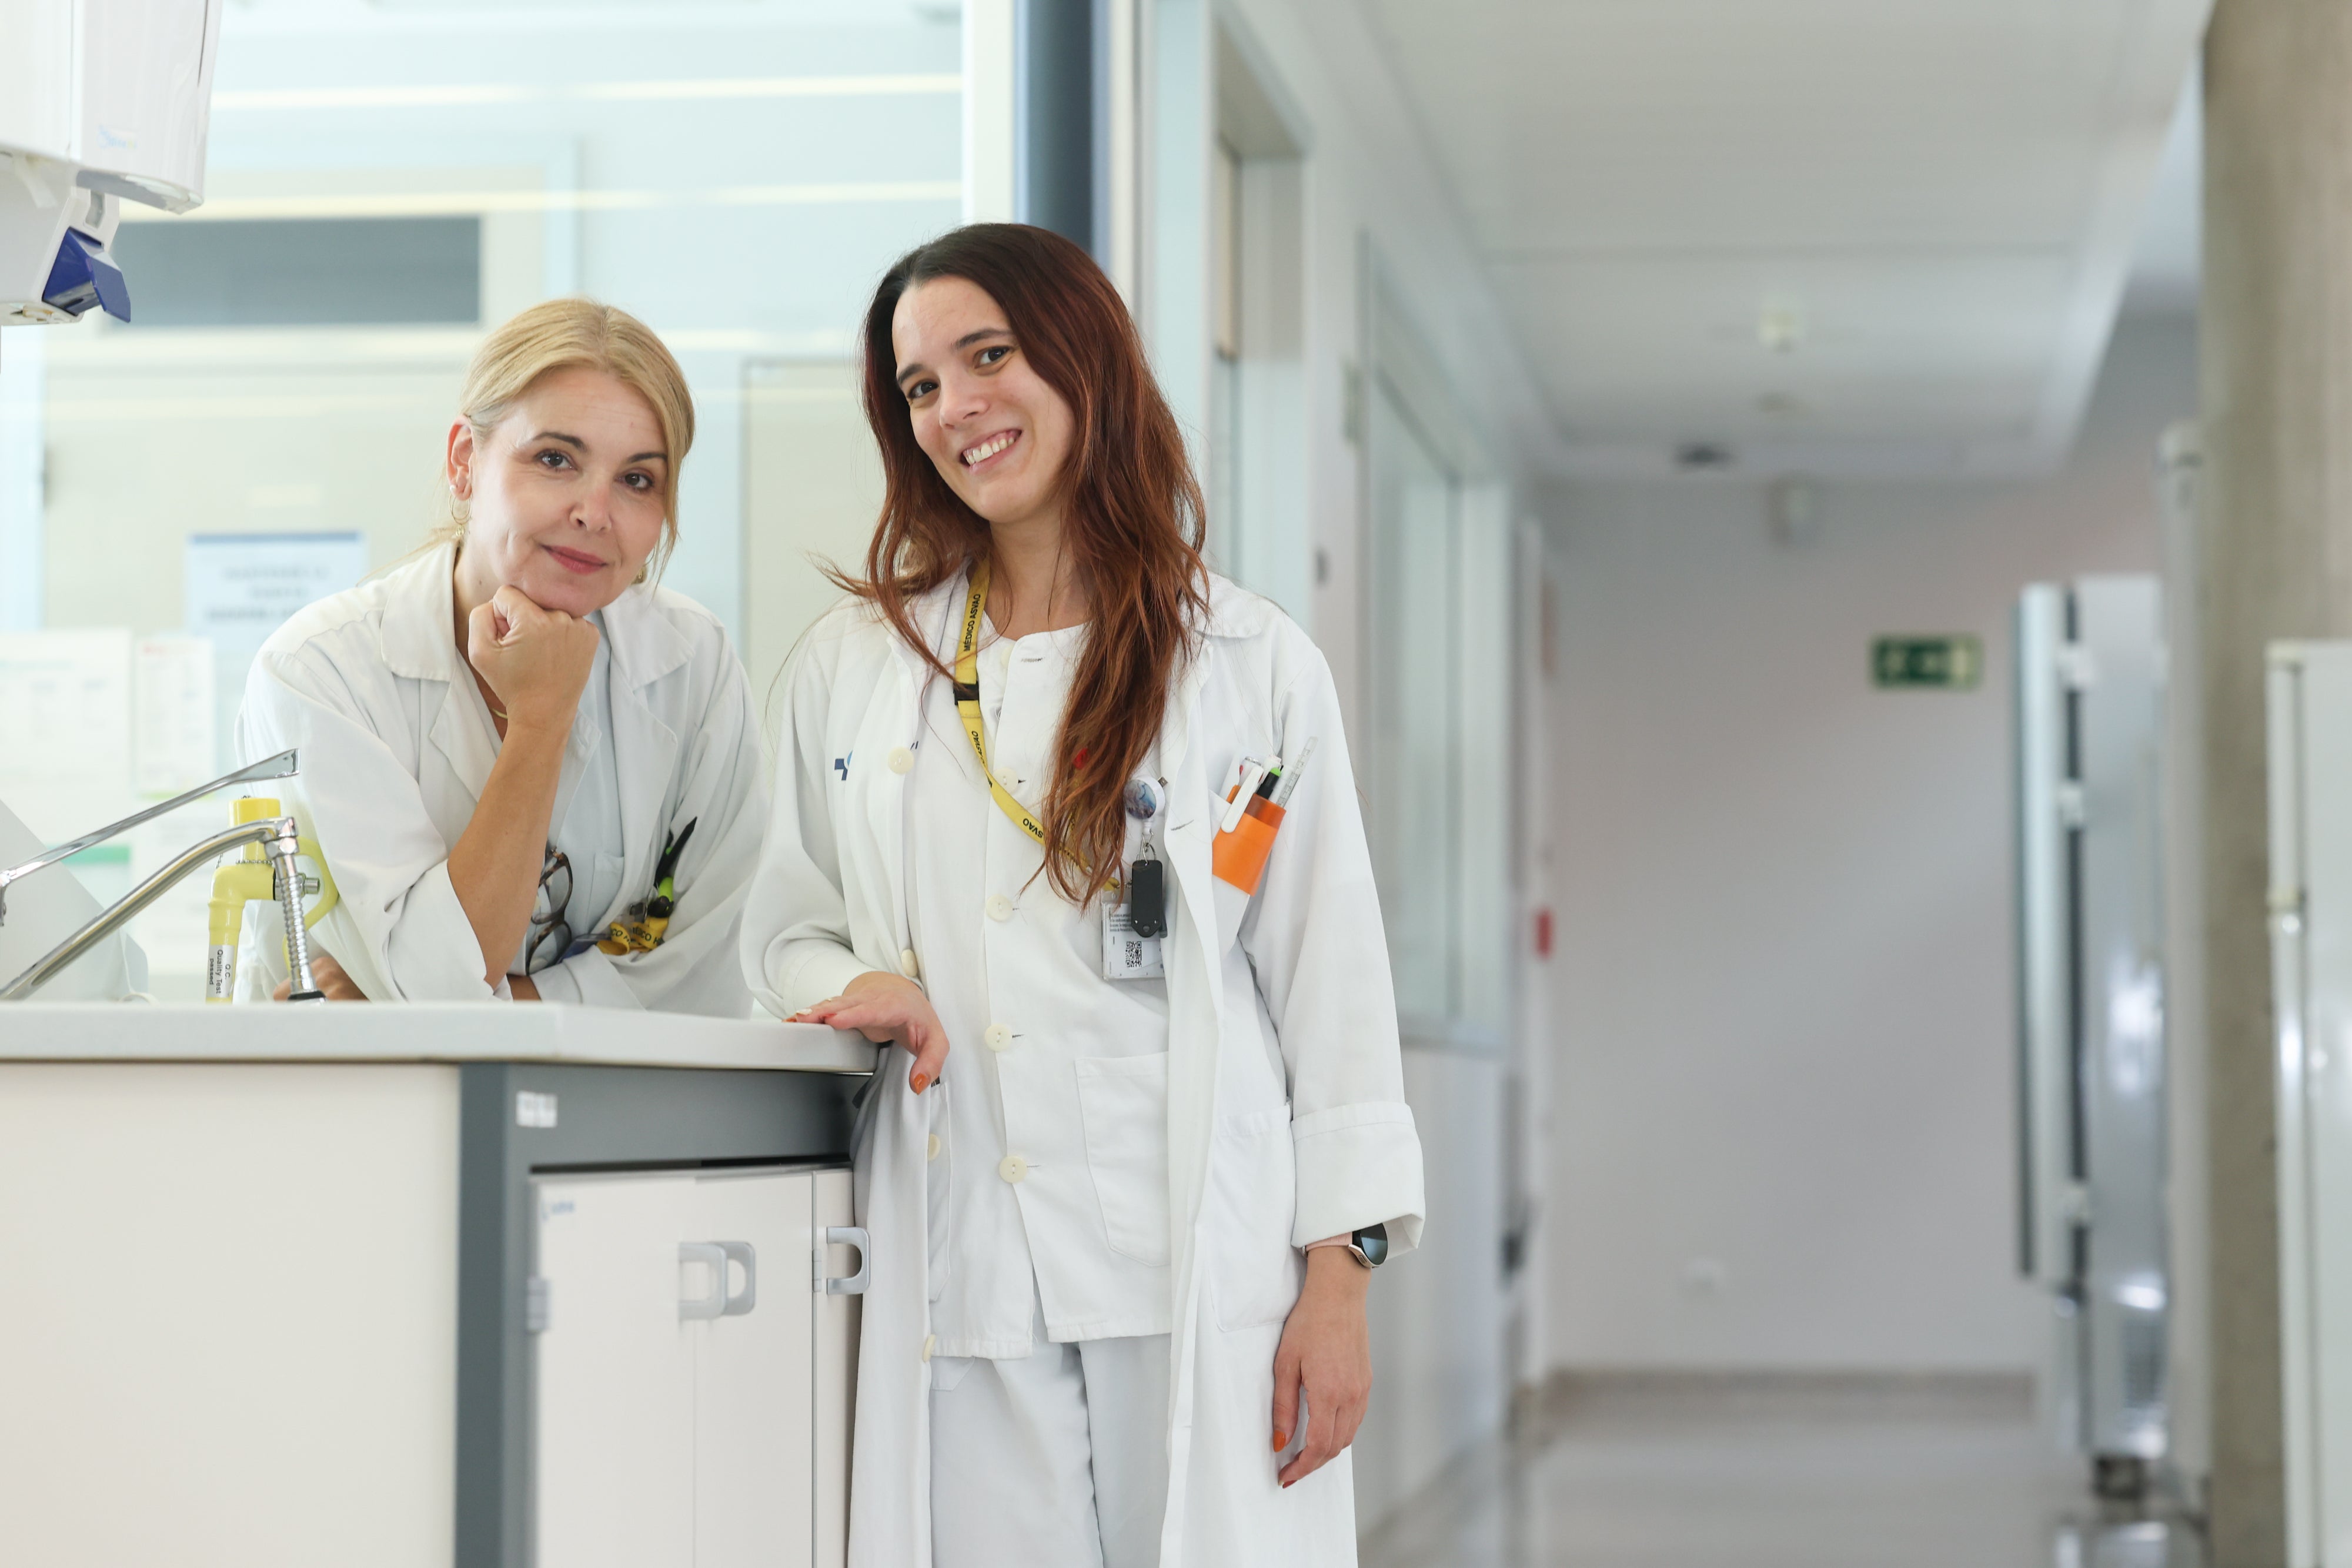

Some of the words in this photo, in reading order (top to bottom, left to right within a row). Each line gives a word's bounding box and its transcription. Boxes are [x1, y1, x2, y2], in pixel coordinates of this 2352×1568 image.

[963, 620, 975, 651] MÉDICO
[969, 593, 981, 619] ASVAO
[1023, 818, 1044, 838] SVAO
[215, 950, 223, 976] Quality
